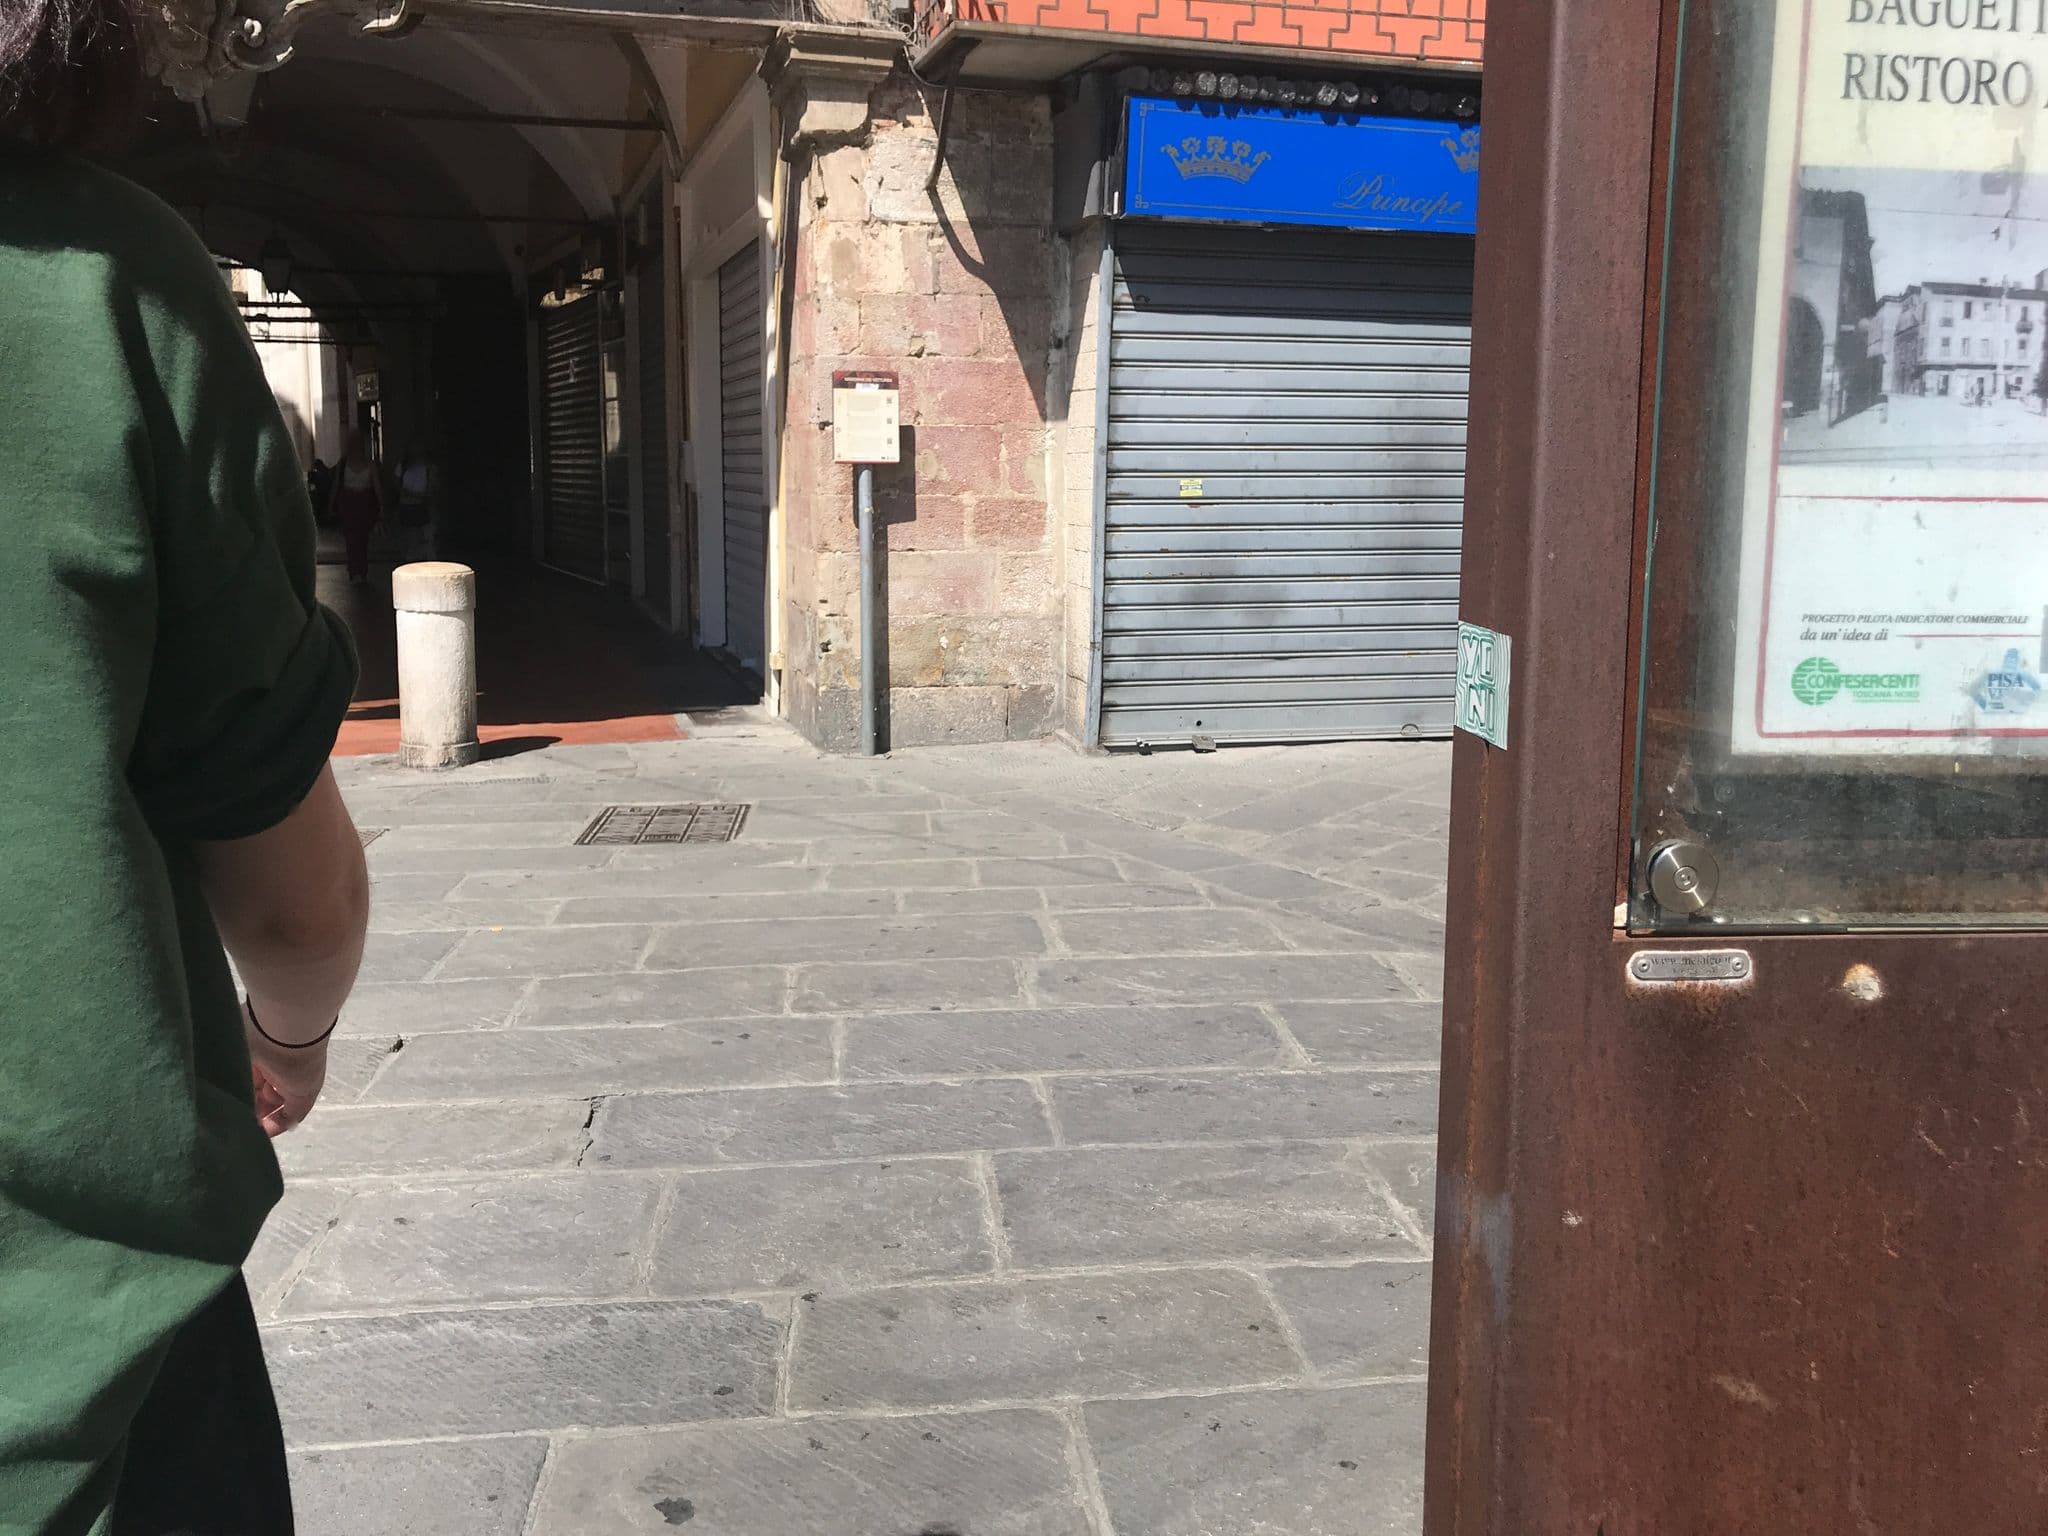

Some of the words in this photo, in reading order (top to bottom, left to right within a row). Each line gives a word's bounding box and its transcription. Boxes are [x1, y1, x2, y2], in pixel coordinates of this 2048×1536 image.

[1840, 53, 2034, 108] RISTORO
[1333, 170, 1463, 223] Principe
[1801, 614, 1856, 624] PROGETTO
[1856, 614, 1893, 624] PILOTA
[1895, 614, 1954, 624] INDICATORI
[1800, 627, 1818, 641] da
[1820, 628, 1842, 641] un'
[1842, 627, 1872, 641] idea
[1874, 627, 1889, 641] di
[1807, 674, 1920, 689] CONFESERCENTI
[1987, 672, 2025, 688] PISA
